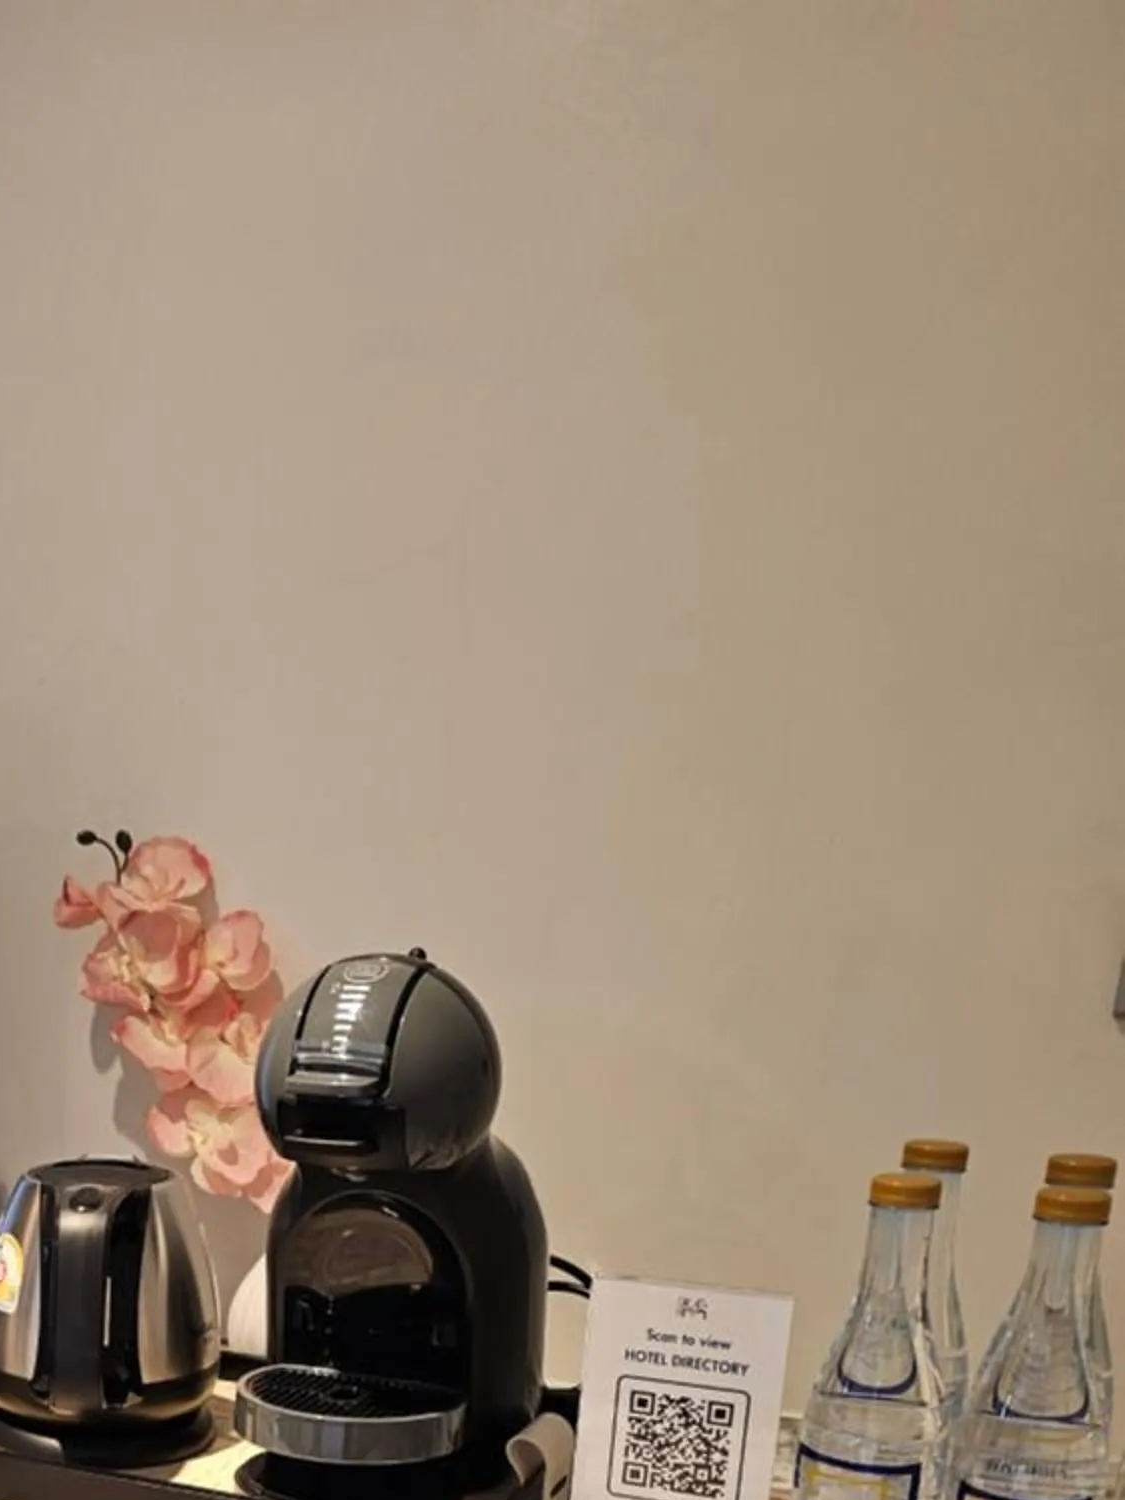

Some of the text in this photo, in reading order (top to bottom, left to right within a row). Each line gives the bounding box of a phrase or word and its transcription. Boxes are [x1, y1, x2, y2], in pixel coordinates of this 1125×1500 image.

[647, 1327, 732, 1350] Scan to view
[624, 1348, 750, 1377] HOTEL DIRECTORY
